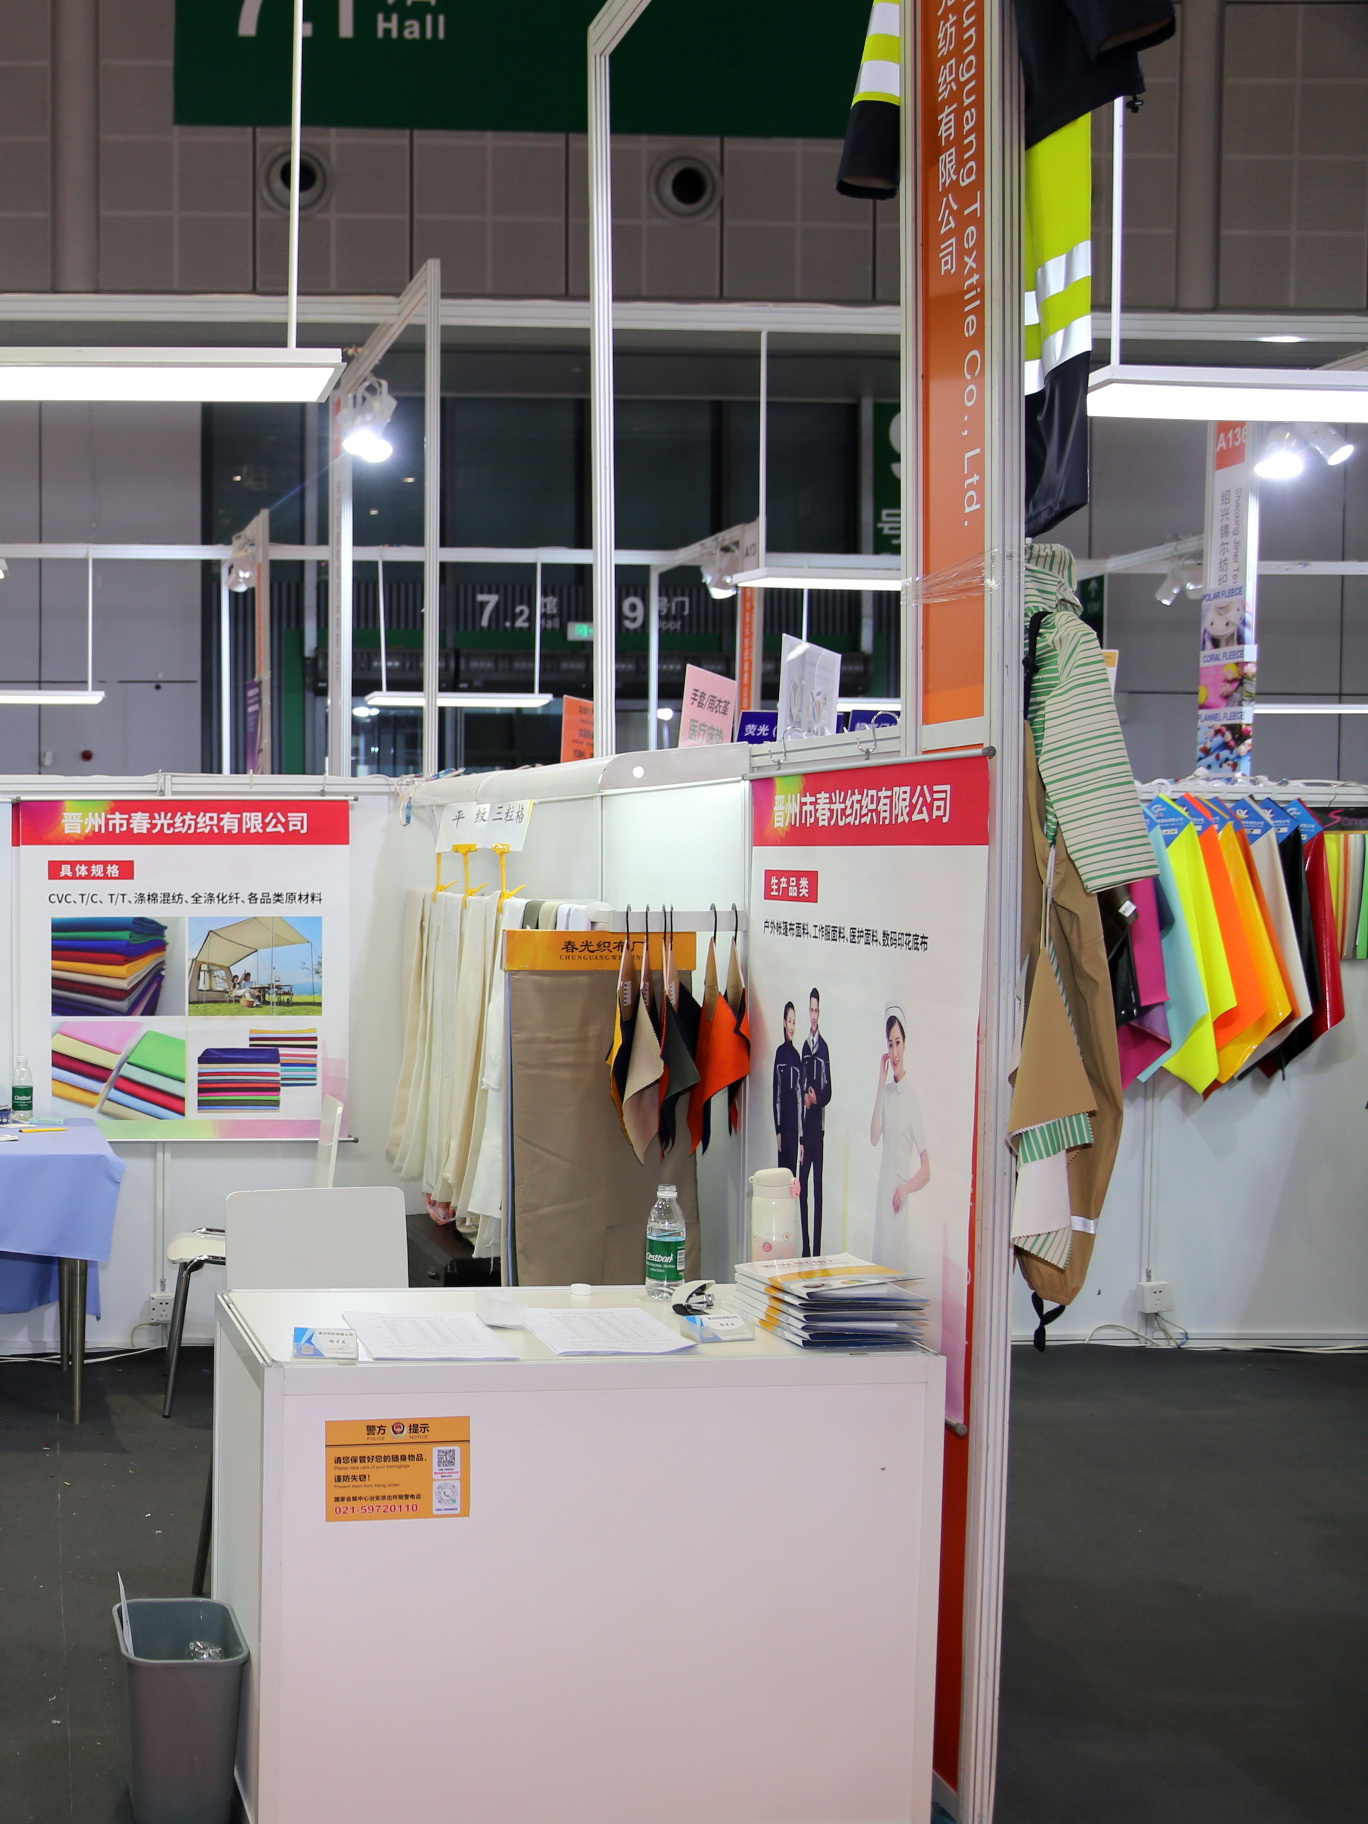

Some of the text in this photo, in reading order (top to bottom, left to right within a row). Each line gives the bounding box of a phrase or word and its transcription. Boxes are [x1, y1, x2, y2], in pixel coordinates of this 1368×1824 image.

[376, 13, 445, 40] Hall
[958, 0, 981, 527] unguang Textile Co., Ltd.
[621, 596, 645, 629] 9
[1222, 650, 1244, 660] FLEECE
[773, 783, 951, 828] 晋州市春光纺织有限公司
[61, 812, 309, 834] 晋州市春光纺织有限公司
[59, 864, 120, 878] 具体规格
[769, 876, 809, 898] 生产品类
[366, 1423, 430, 1436] 警方 提示
[334, 1474, 371, 1483] 谨防失窃！
[334, 1503, 419, 1515] 021-59720110
